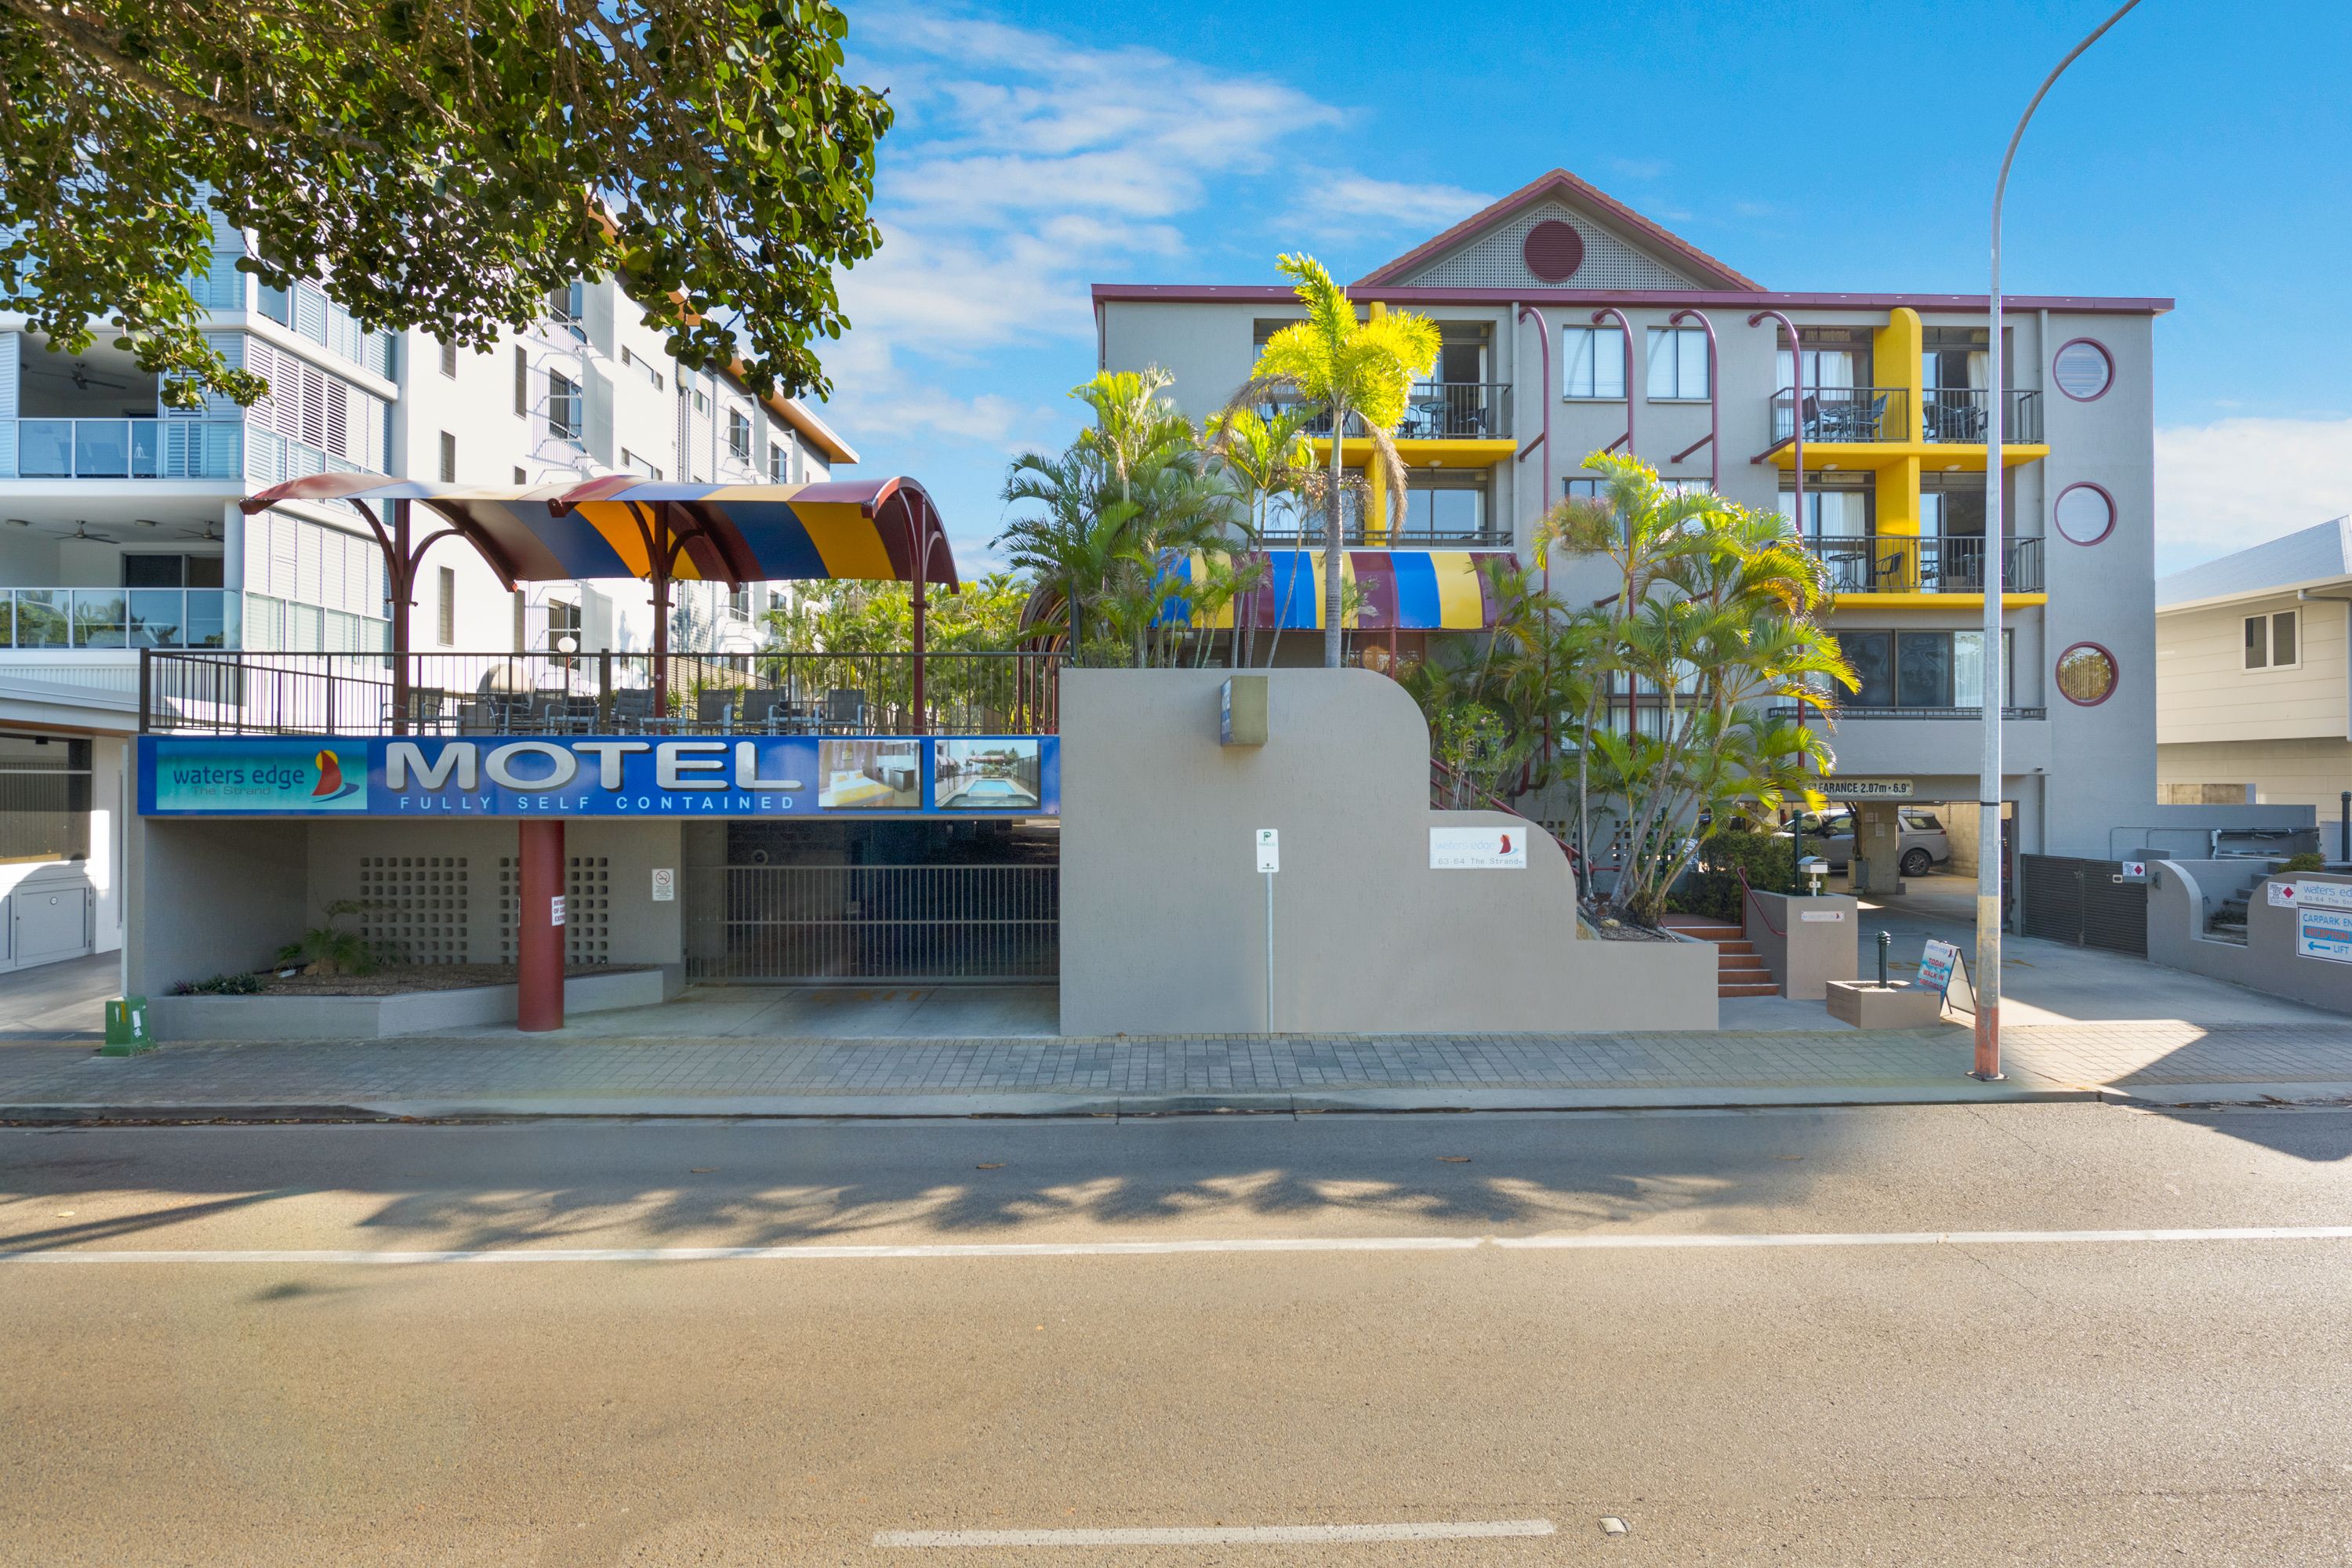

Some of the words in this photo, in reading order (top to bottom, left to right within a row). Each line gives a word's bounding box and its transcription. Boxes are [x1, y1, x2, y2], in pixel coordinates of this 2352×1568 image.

[386, 741, 803, 789] MOTEL
[173, 764, 245, 785] waters
[252, 765, 304, 789] edge
[192, 786, 216, 796] The
[223, 786, 270, 796] Strand
[1860, 783, 1886, 793] 2.07m
[401, 797, 491, 809] FULLY
[518, 797, 590, 809] SELF
[616, 797, 793, 809] CONTAINED
[1263, 831, 1272, 841] P
[2303, 885, 2335, 895] waters
[2303, 913, 2340, 926] CARPARK
[2305, 927, 2349, 941] RECEPTION
[2333, 944, 2349, 954] LIFT
[1929, 958, 1945, 967] TODAY
[1923, 969, 1936, 978] WALK
